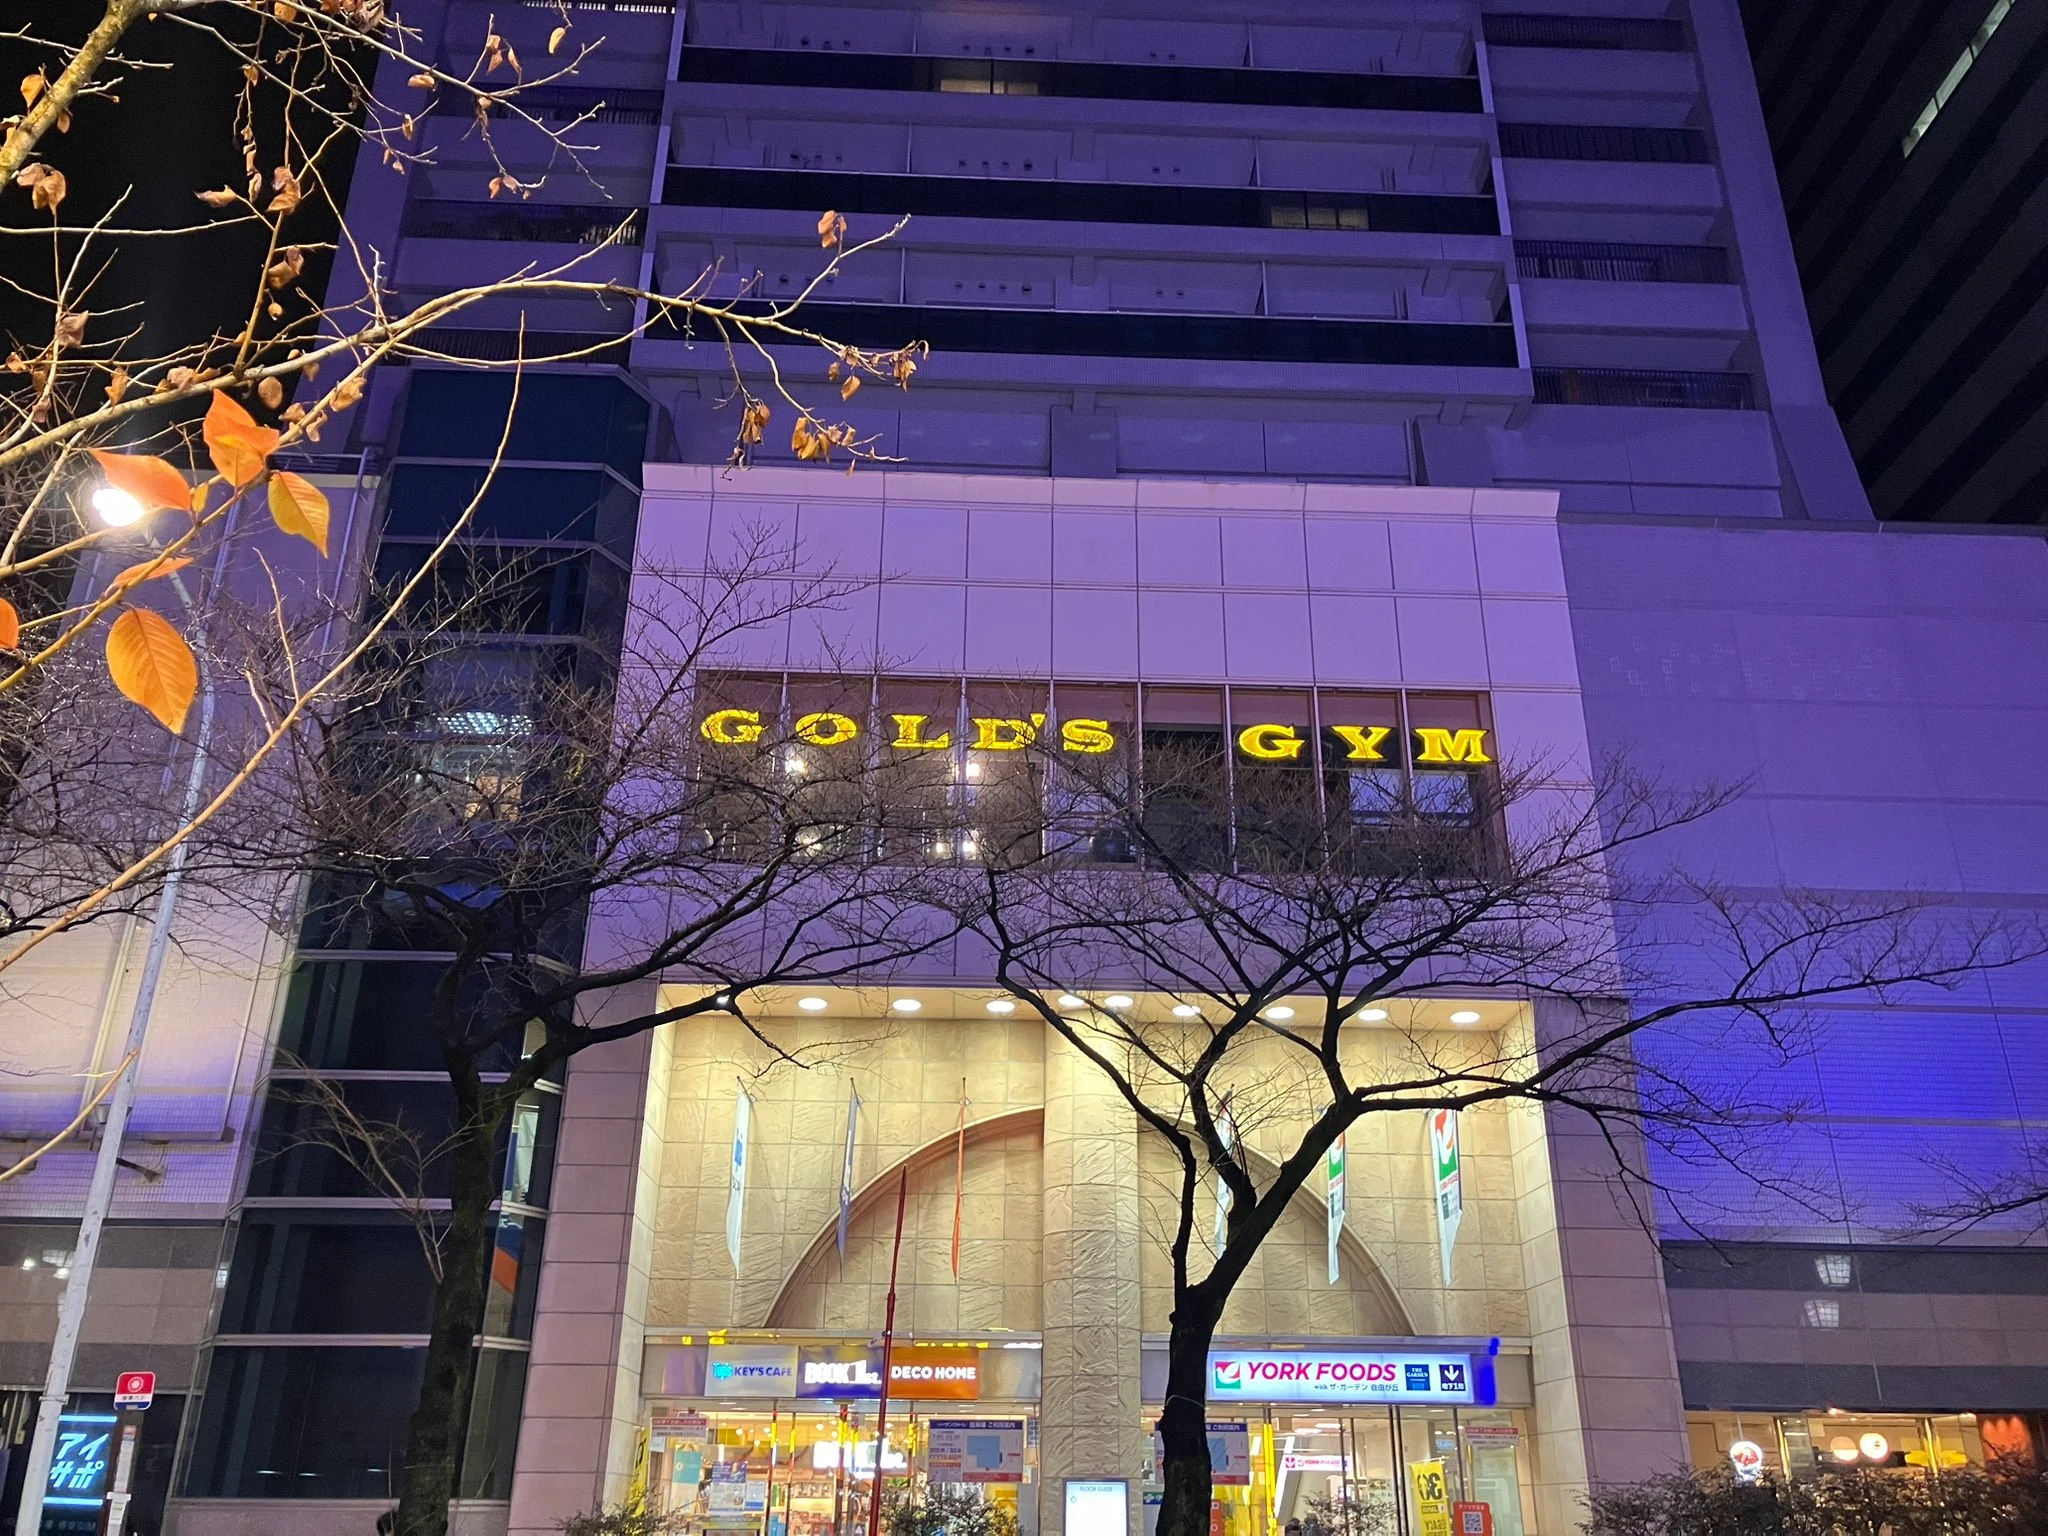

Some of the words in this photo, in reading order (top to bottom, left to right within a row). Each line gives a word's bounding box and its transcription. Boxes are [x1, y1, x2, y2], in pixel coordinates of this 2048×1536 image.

[700, 708, 1115, 754] GOLD'S
[1237, 722, 1492, 764] GYM
[734, 1366, 765, 1377] KEY'S
[891, 1365, 933, 1380] DECO
[934, 1366, 977, 1380] HOME
[1247, 1361, 1313, 1381] YORK
[1315, 1362, 1397, 1382] FOODS
[55, 1433, 110, 1461] アイ
[49, 1460, 105, 1489] サポ
